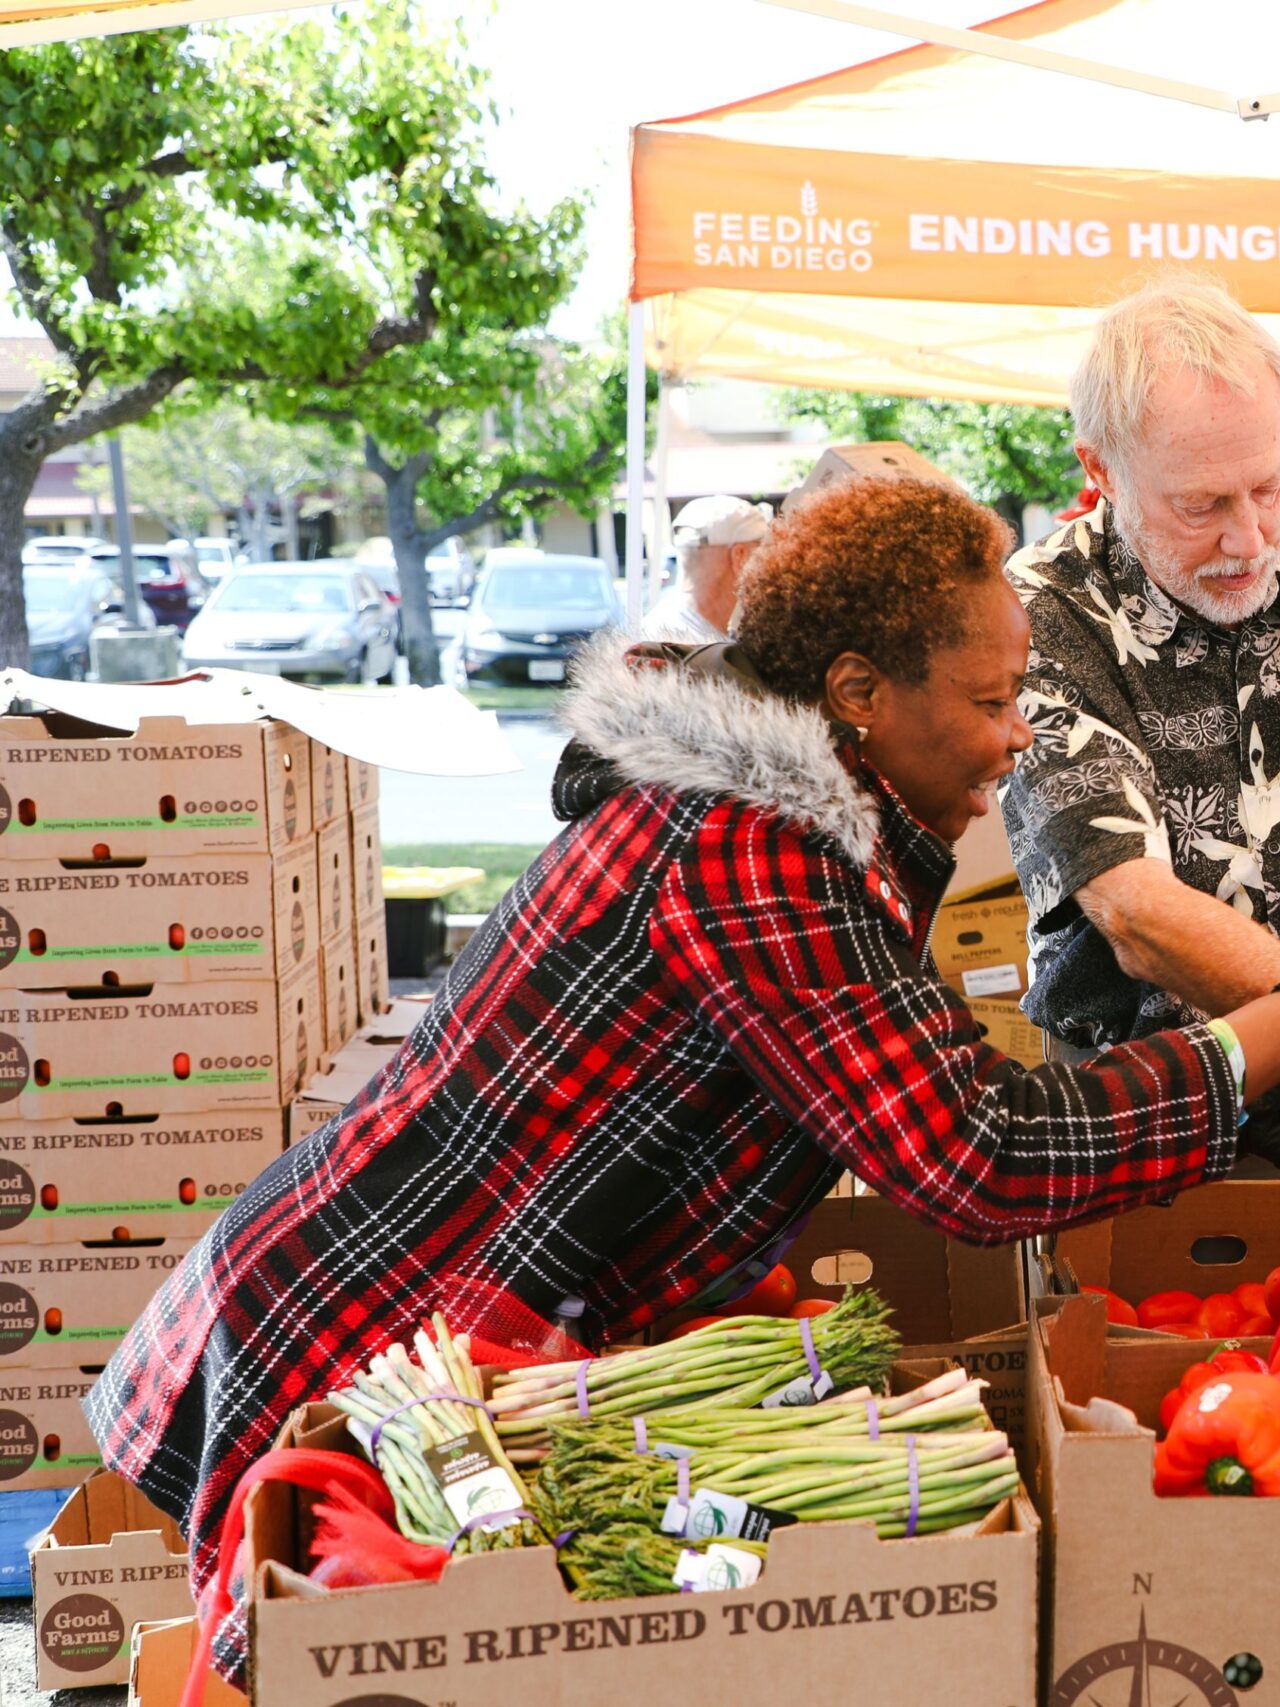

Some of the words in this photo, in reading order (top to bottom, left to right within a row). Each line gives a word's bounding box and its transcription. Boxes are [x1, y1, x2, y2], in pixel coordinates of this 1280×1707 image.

[694, 211, 872, 246] FEEDING
[909, 213, 1111, 257] ENDING
[694, 243, 759, 269] SAN
[786, 245, 872, 272] DIEGO
[8, 748, 111, 763] RIPENED
[118, 744, 243, 762] TOMATOES
[16, 875, 119, 892] RIPENED
[126, 871, 249, 888] TOMATOES
[26, 1005, 129, 1024] RIPENED
[137, 1001, 259, 1018] TOMATOES
[32, 1132, 134, 1150] RIPENED
[141, 1127, 264, 1145] TOMATOES
[38, 1256, 140, 1273] RIPENED
[953, 1351, 1025, 1373] TOE
[54, 1569, 114, 1587] VINE
[1131, 1572, 1153, 1595] N
[54, 1610, 111, 1629] Good
[309, 1635, 448, 1679] VINE
[463, 1608, 707, 1663] RIPENED
[722, 1579, 998, 1636] TOMATOES
[45, 1630, 120, 1648] Farms
